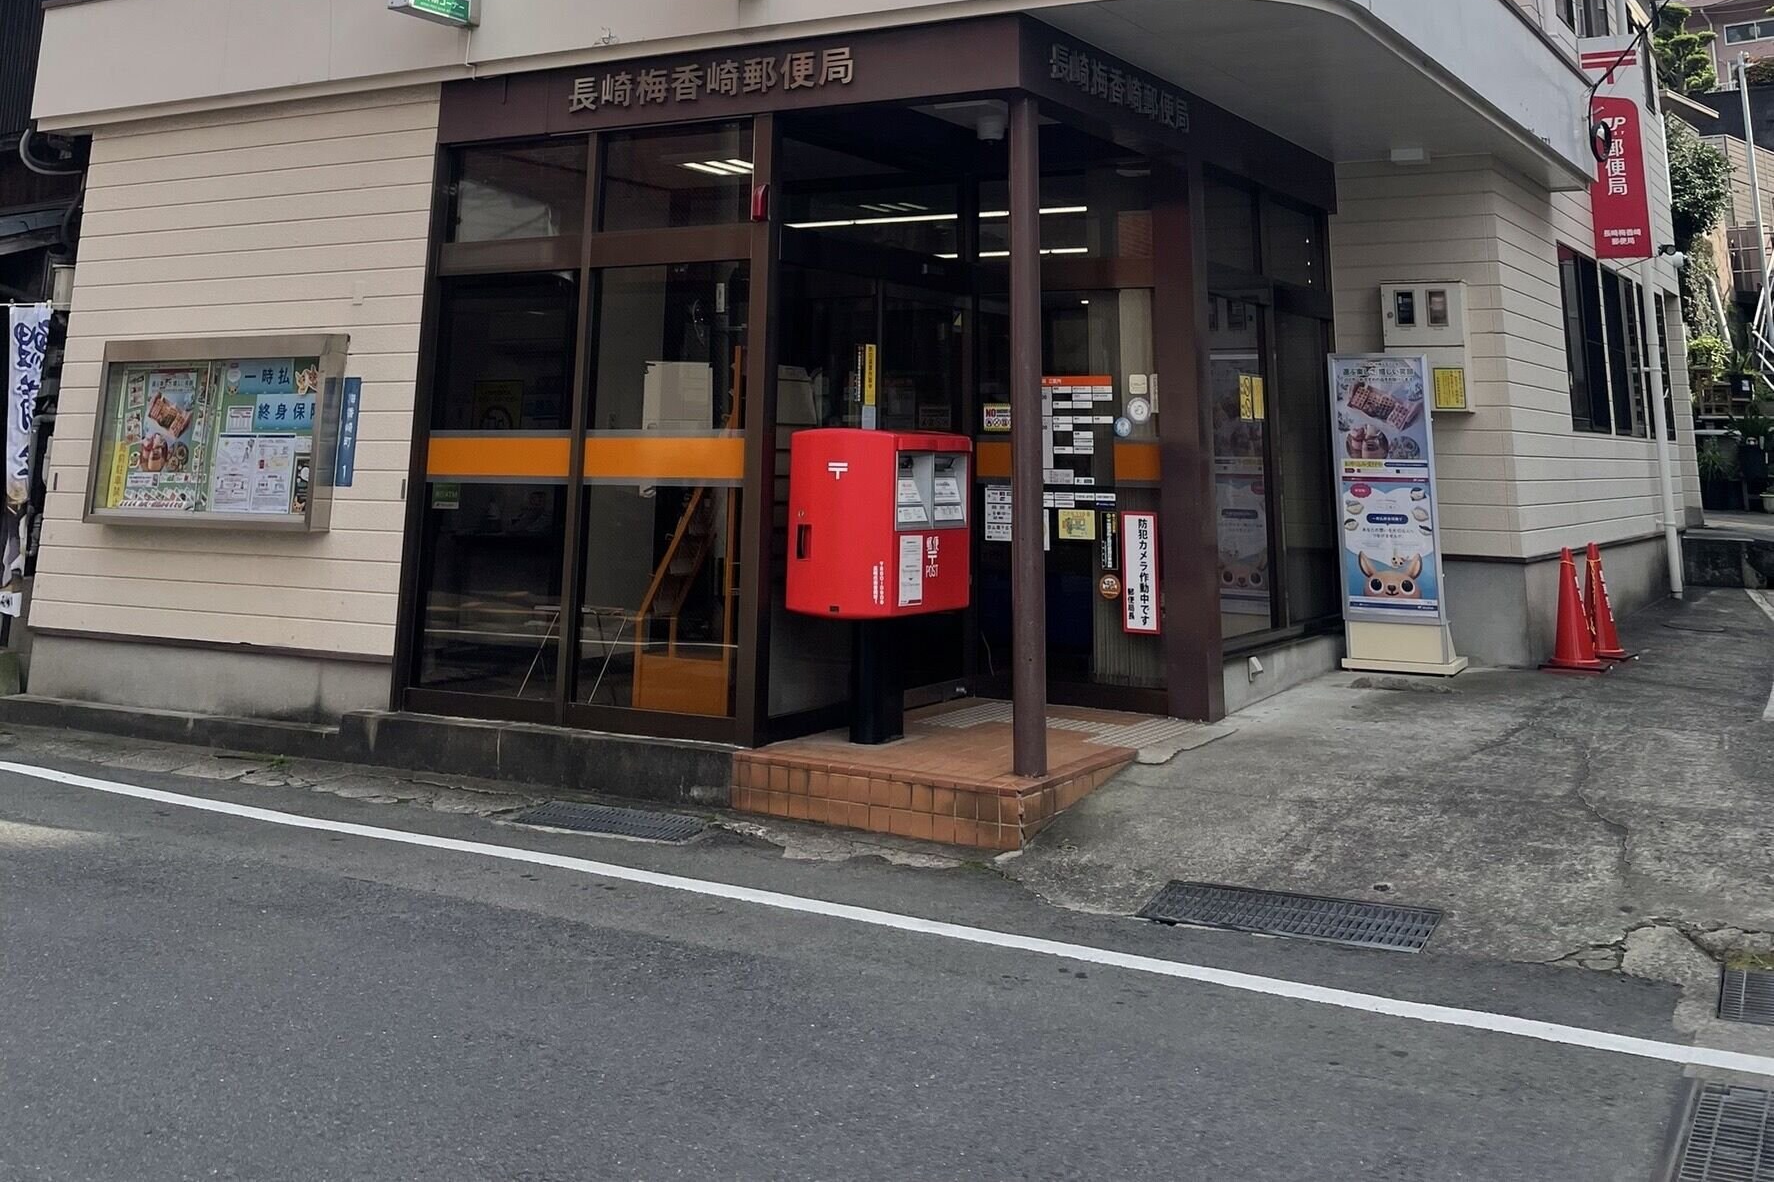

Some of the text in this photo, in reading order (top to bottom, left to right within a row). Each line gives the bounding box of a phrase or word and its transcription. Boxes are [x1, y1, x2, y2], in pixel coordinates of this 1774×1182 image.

[568, 46, 855, 115] 長崎梅香崎郵便局
[1050, 43, 1191, 133] 長崎梅香崎郵便局
[245, 368, 290, 385] 一時払
[925, 564, 939, 578] POST
[1138, 518, 1150, 626] 防犯カメラ作動中です
[1127, 587, 1136, 620] 郵便局長
